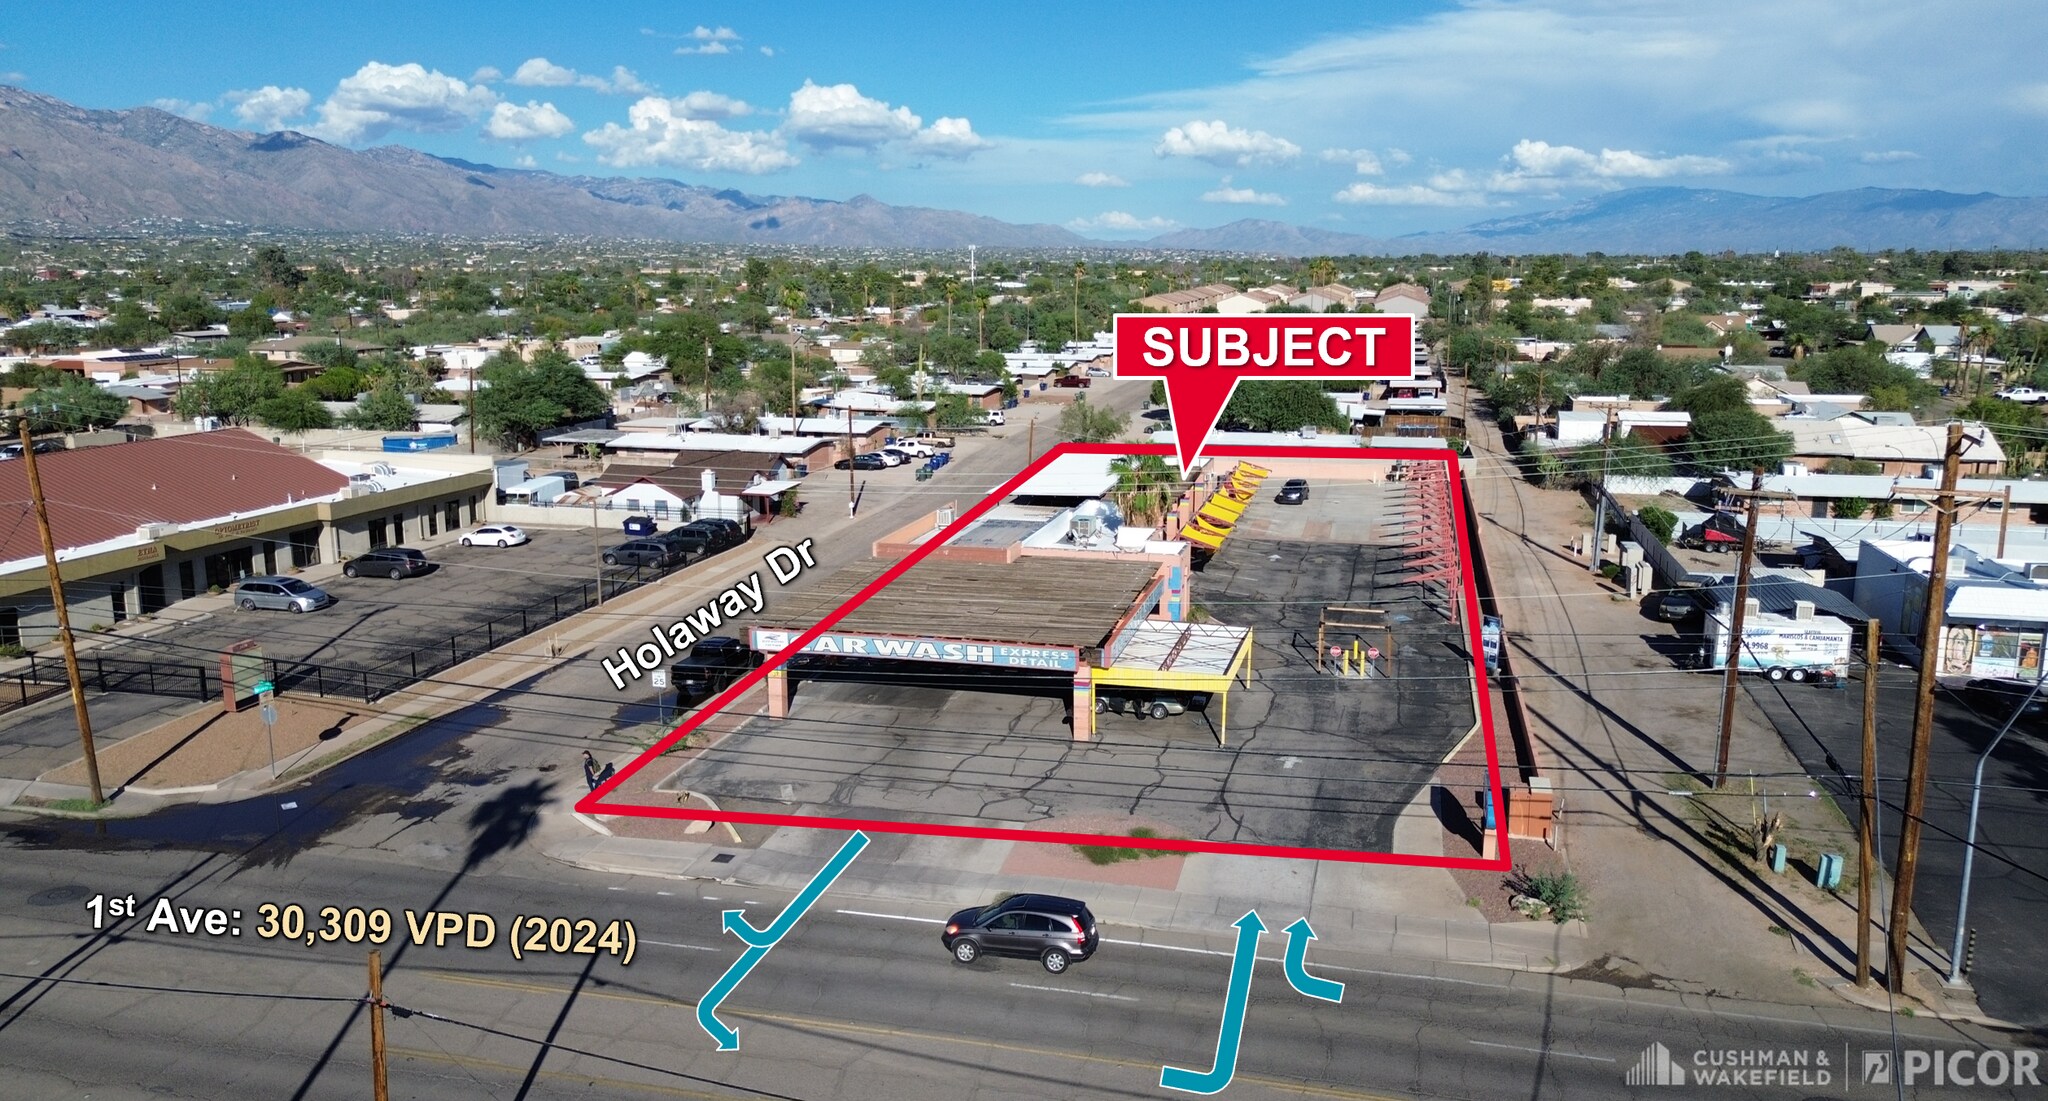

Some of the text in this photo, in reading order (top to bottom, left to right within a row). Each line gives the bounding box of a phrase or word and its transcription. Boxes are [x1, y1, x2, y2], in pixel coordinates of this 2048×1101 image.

[214, 519, 260, 535] OPTOMETRIST
[1779, 633, 1804, 641] MARISCOS
[873, 639, 994, 663] WASH
[1000, 647, 1069, 660] EXPRESS
[1009, 657, 1061, 668] DETAIL
